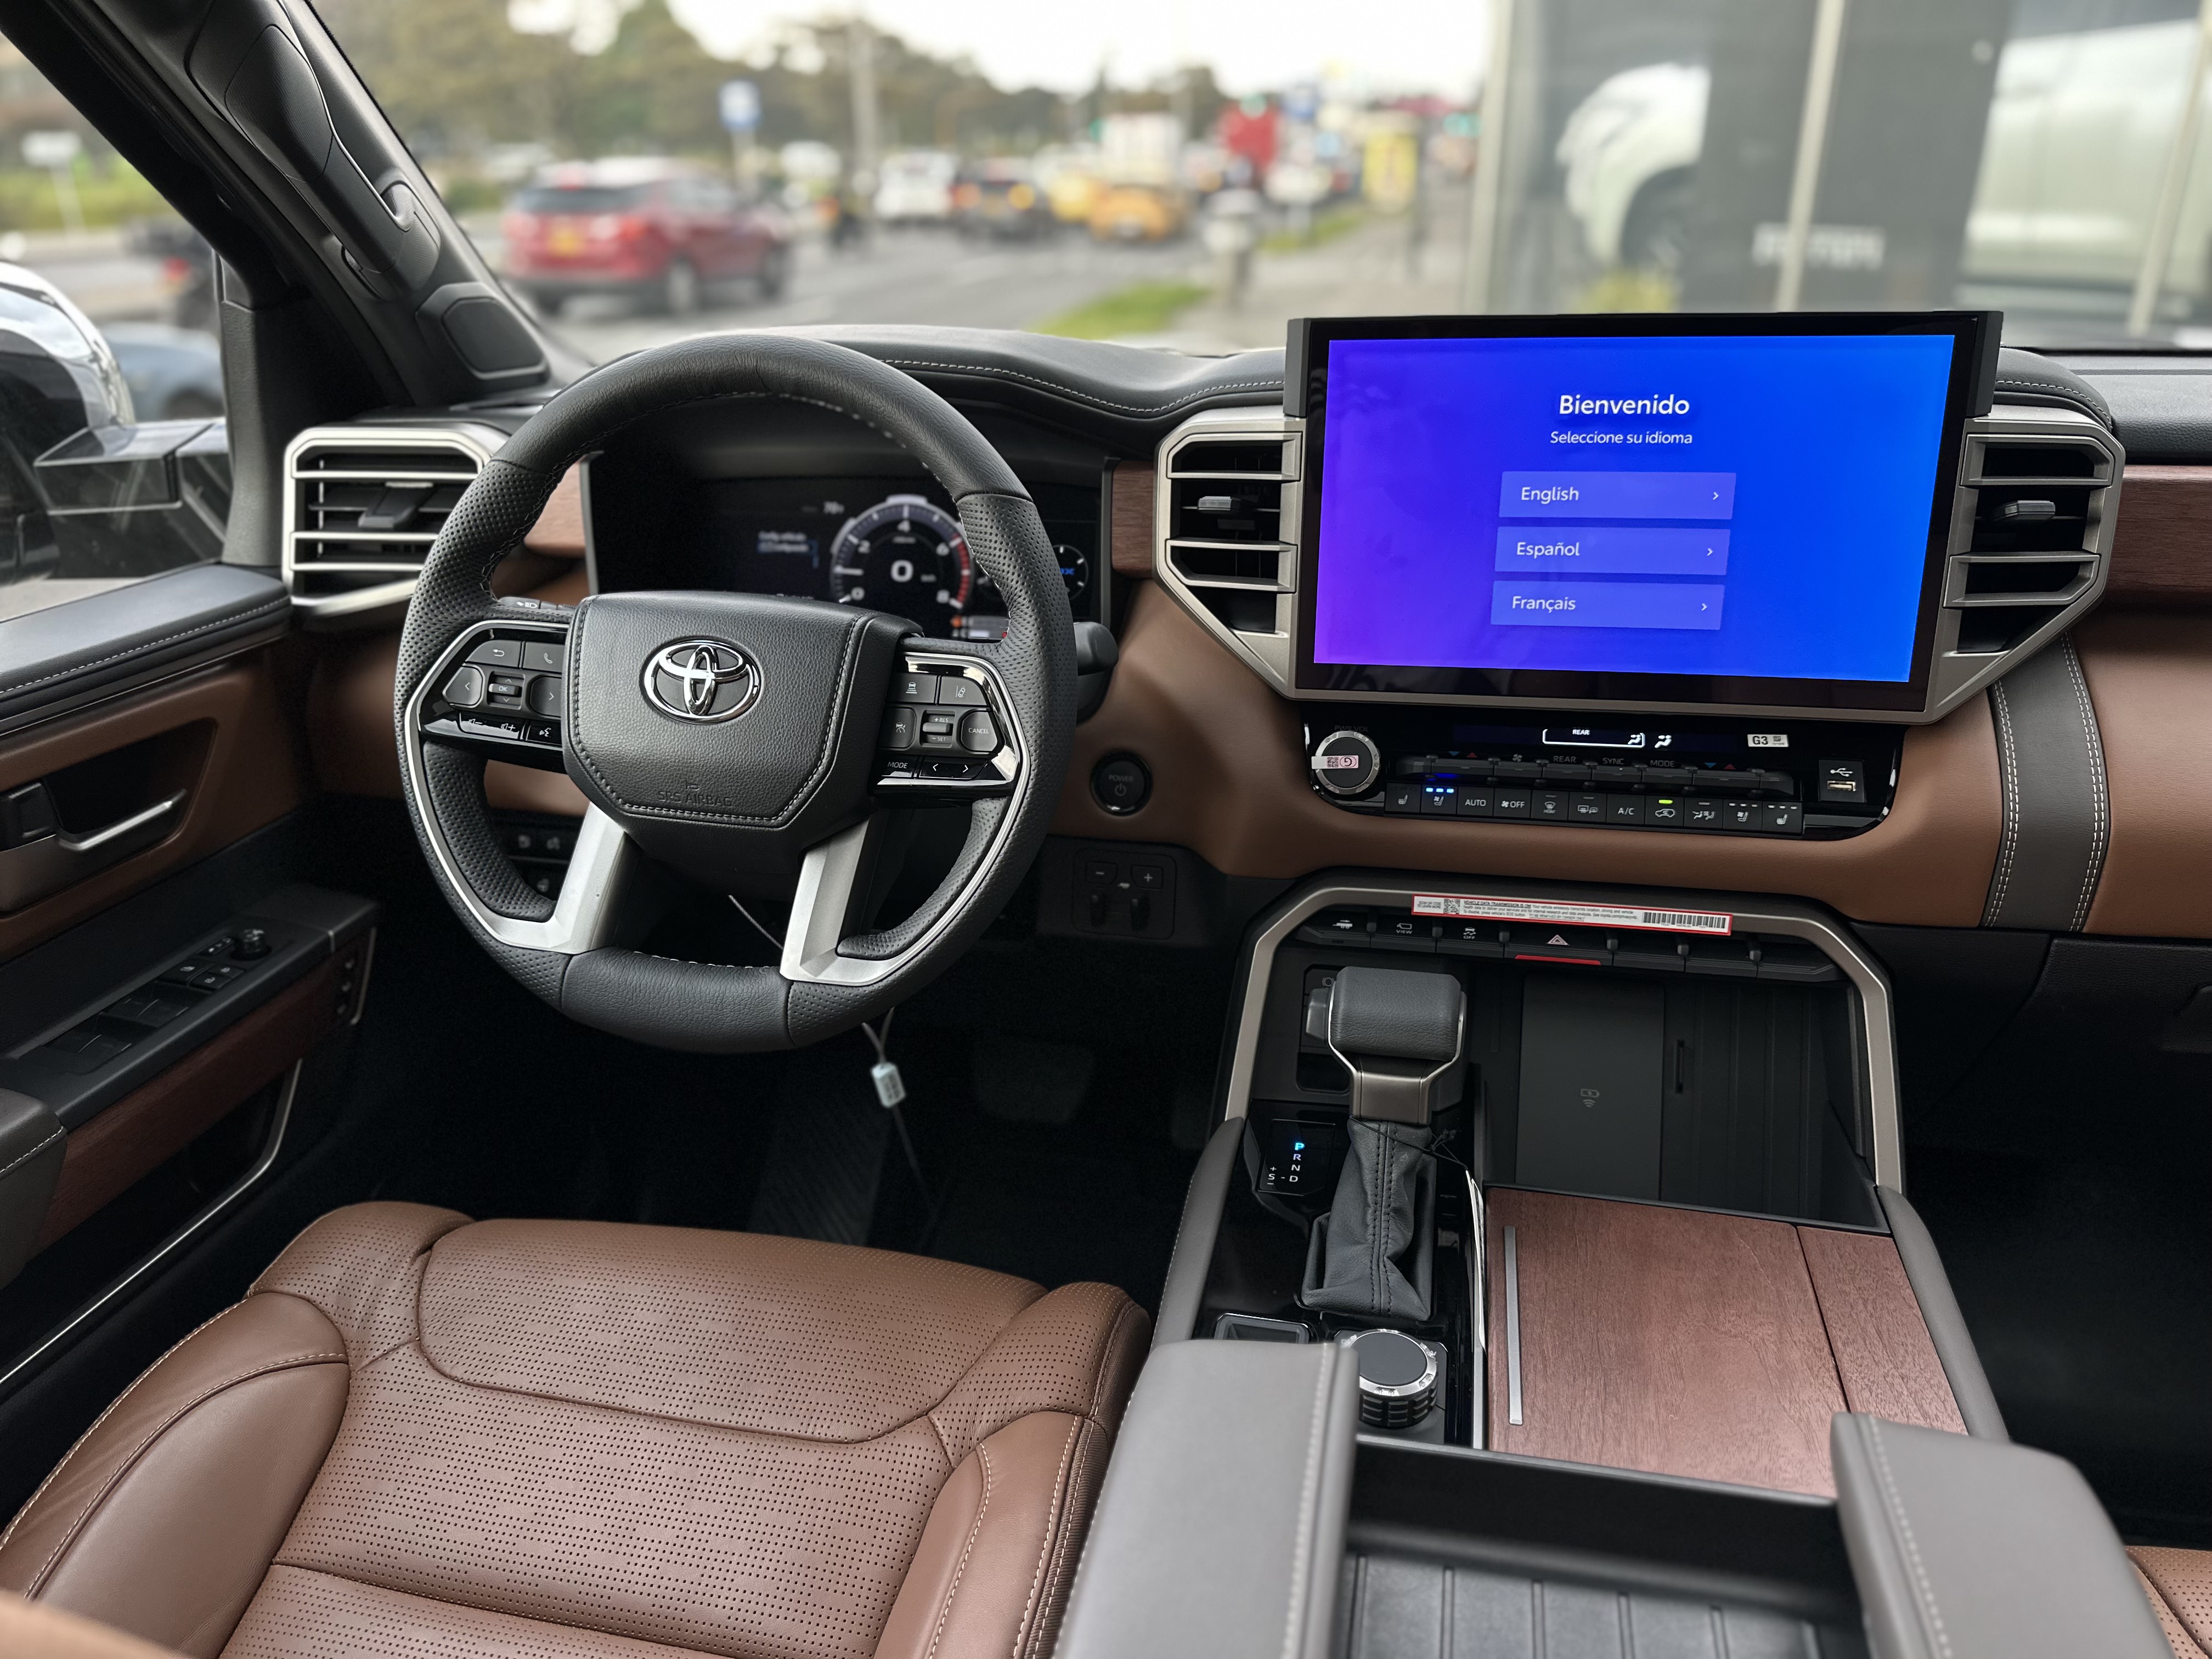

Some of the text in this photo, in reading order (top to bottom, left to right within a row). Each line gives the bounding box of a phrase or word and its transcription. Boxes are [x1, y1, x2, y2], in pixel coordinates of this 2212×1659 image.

[1559, 394, 1690, 415] Bienvenido
[1550, 431, 1692, 444] Seleccione su idioma
[1521, 487, 1579, 504] English
[1517, 542, 1580, 558] Español
[1512, 596, 1576, 613] Français
[1752, 736, 1768, 745] G3
[686, 794, 732, 806] AIRBAG
[1465, 799, 1487, 807] AUTO
[1510, 800, 1525, 809] OFF
[1618, 807, 1634, 816] A/C
[1295, 1142, 1305, 1150] P
